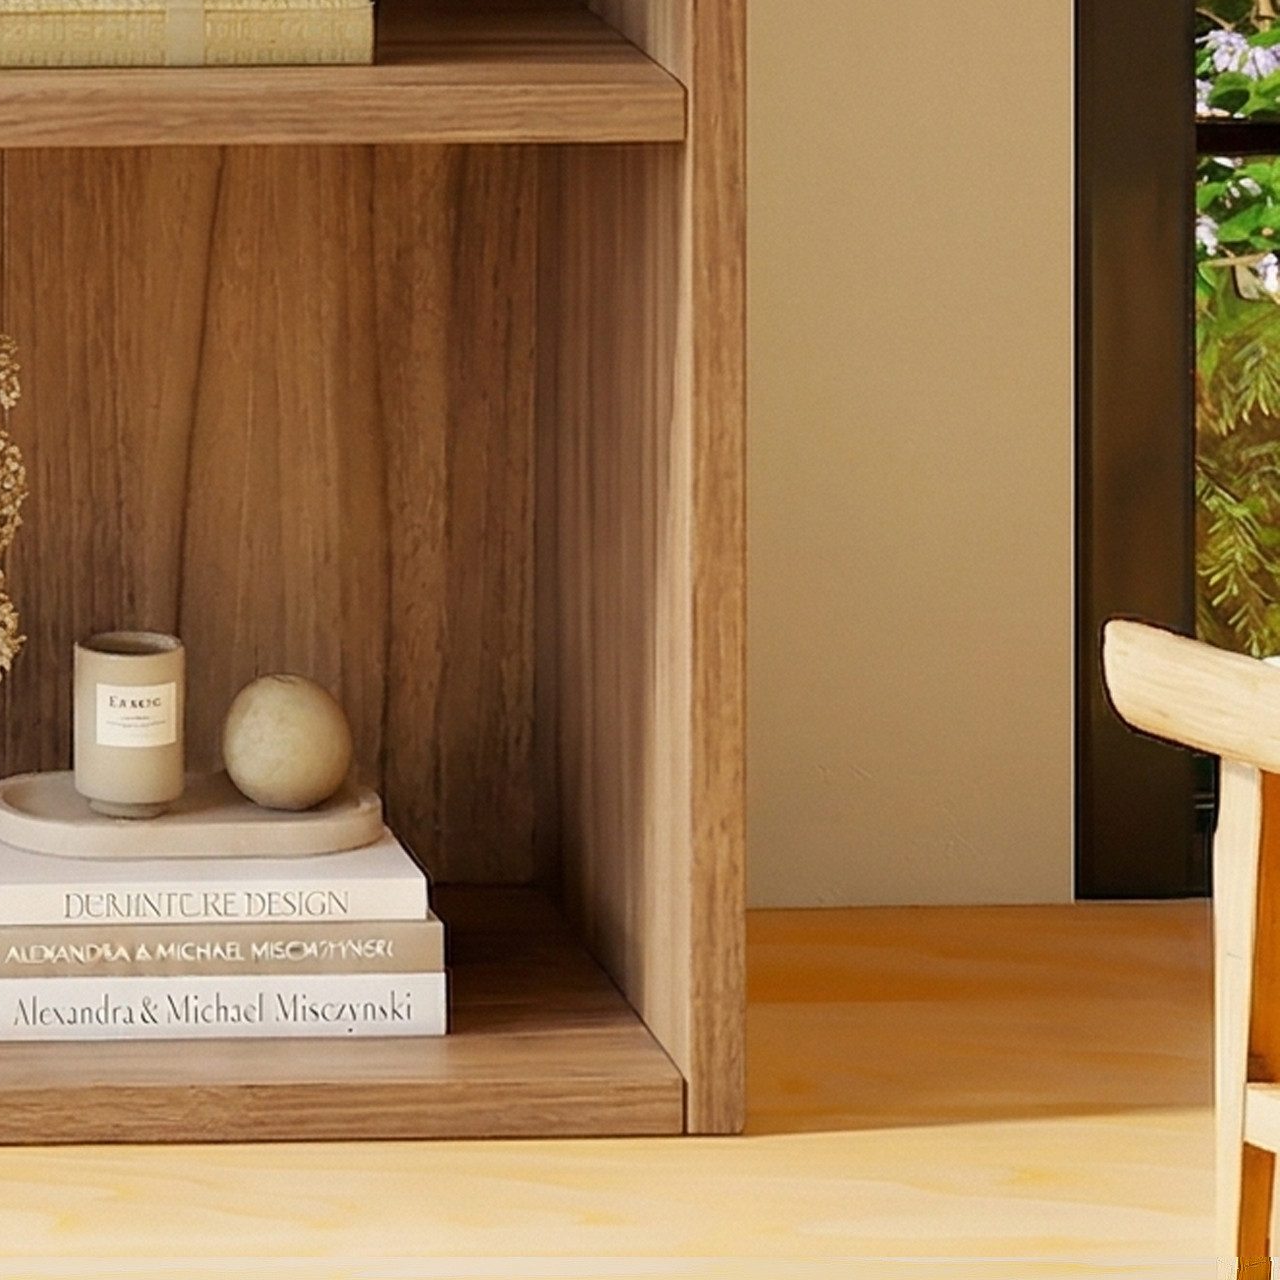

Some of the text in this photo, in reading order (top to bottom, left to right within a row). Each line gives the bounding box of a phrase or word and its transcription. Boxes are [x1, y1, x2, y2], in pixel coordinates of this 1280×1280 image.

[244, 890, 349, 917] DESIGN
[13, 989, 413, 1029] Alexandra & Michael Misczynski
